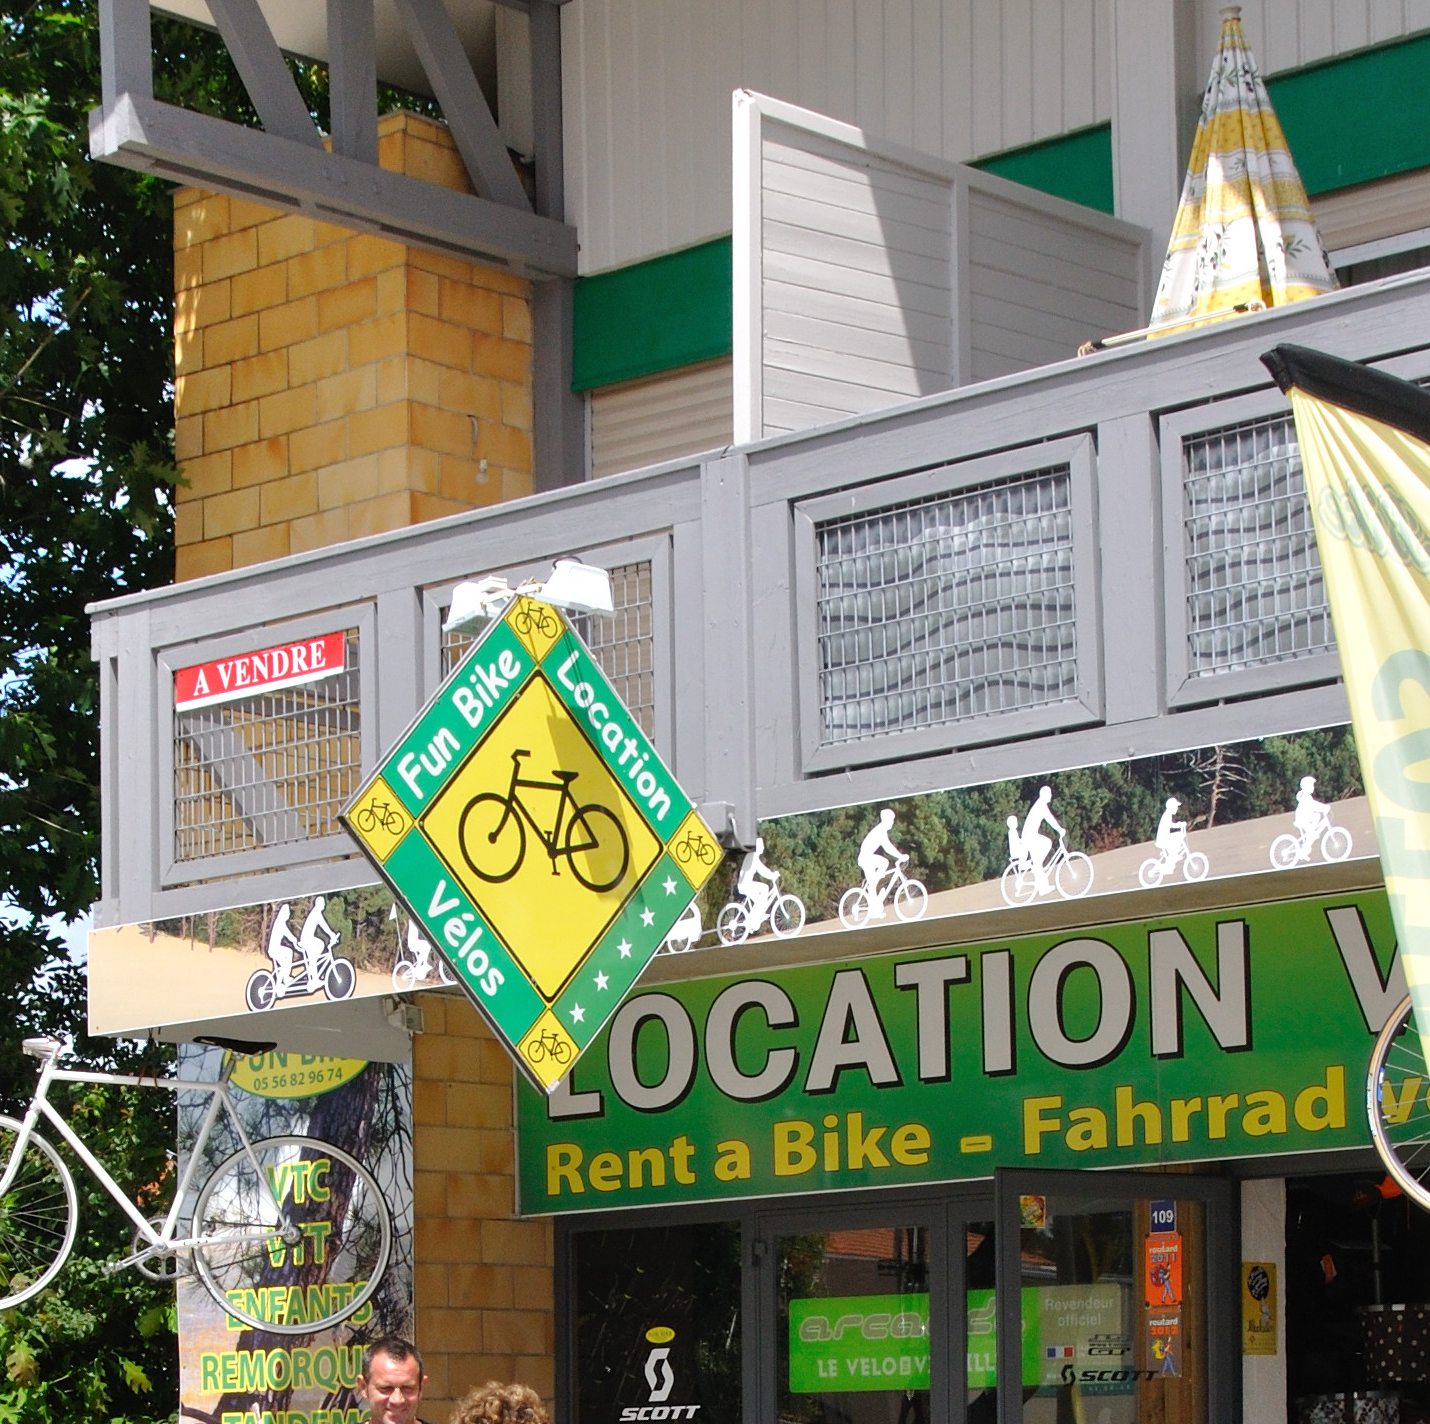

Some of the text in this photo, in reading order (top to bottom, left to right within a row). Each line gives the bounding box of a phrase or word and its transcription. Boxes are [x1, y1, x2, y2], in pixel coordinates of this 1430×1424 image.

[192, 638, 326, 696] A VENDRE
[397, 647, 522, 800] Fun Bike
[556, 648, 673, 821] Location
[428, 879, 506, 999] Vélos
[254, 1067, 343, 1091] 05 56 82 96 74
[546, 1134, 697, 1197] Rent
[713, 1139, 752, 1181] a
[773, 1112, 932, 1178] Bike
[1022, 1064, 1346, 1157] Fahrrad
[266, 1158, 331, 1205] VTC
[1152, 1209, 1175, 1225] 109
[266, 1222, 331, 1269] VTT
[225, 1281, 373, 1332] ENFANTS
[1044, 1297, 1114, 1312] Revendeur
[1058, 1314, 1102, 1328] officiel
[1148, 1316, 1179, 1327] routard
[818, 1358, 838, 1378] LE
[1079, 1370, 1159, 1382] SCOTT
[619, 1404, 702, 1421] SCOTT
